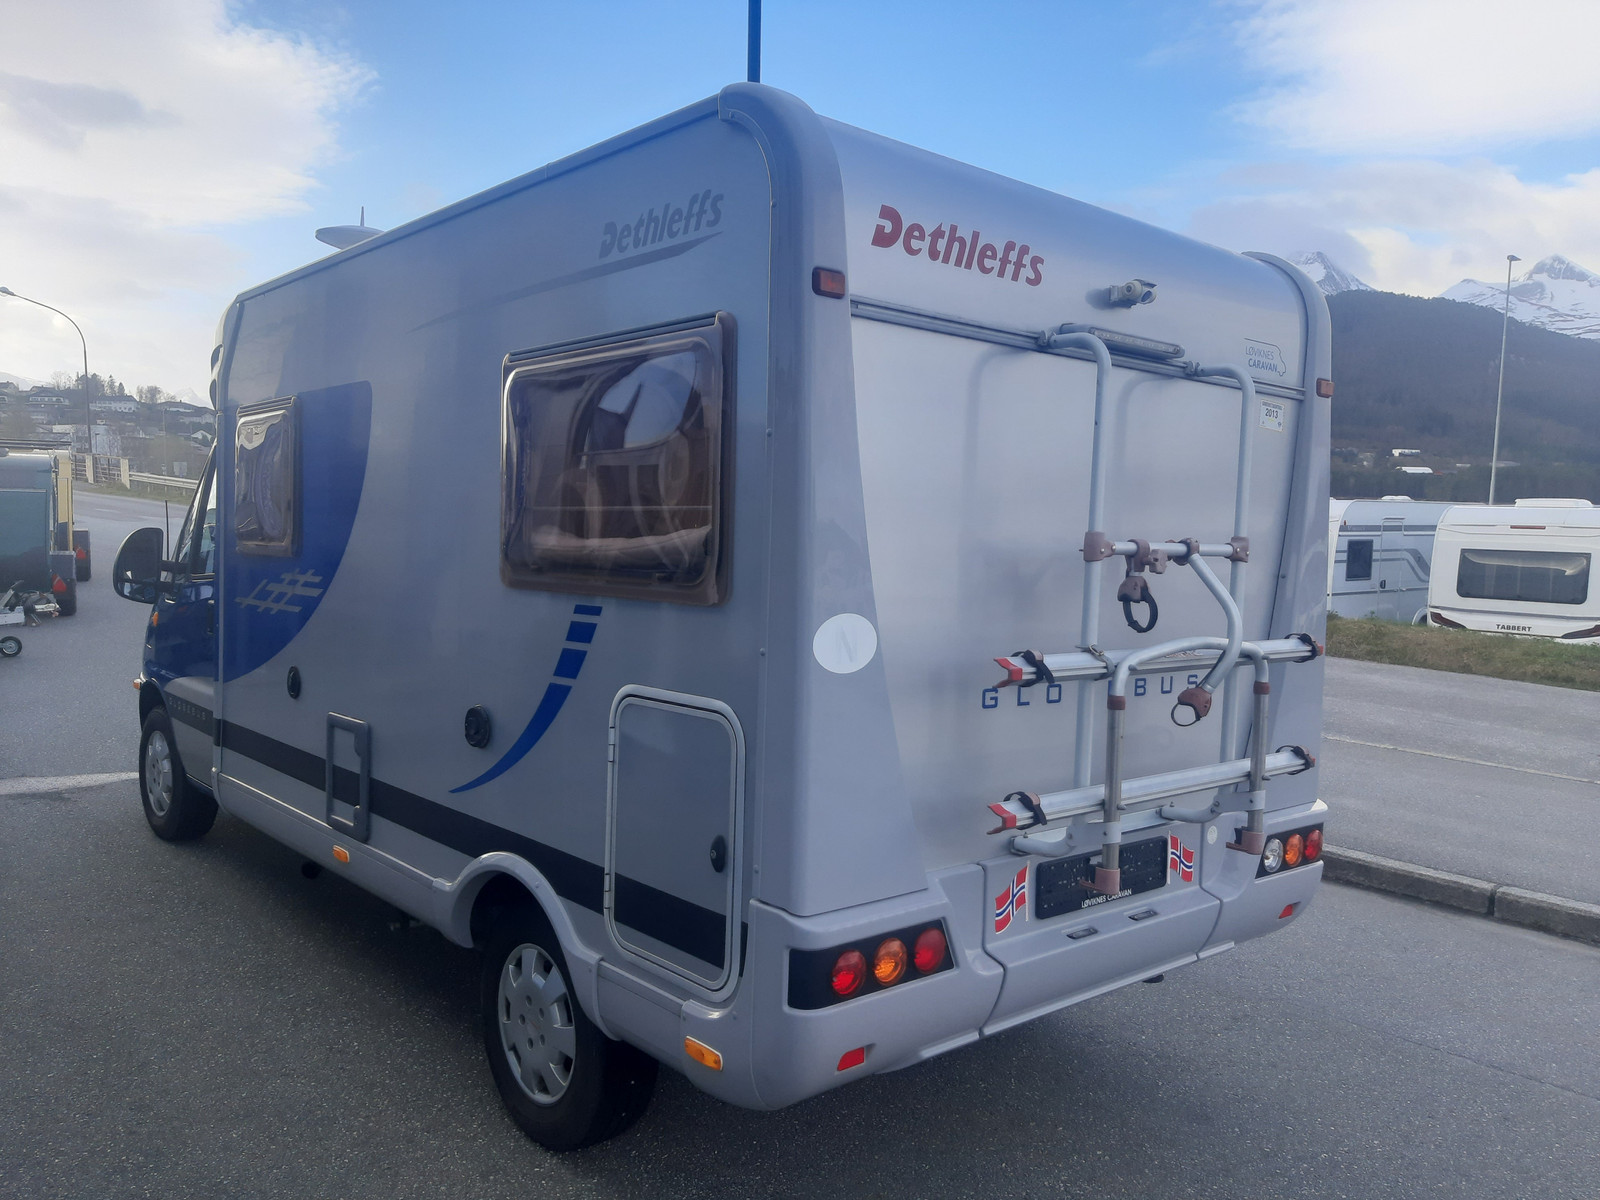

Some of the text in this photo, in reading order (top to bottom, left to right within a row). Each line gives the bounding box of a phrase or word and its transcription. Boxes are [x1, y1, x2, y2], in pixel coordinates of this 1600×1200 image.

[599, 188, 725, 259] Dethleffs
[871, 203, 1045, 287] Dethleffs
[1245, 345, 1275, 361] LØVIKNES
[1248, 358, 1278, 373] CARAVAN
[1265, 407, 1279, 419] 2013
[1496, 623, 1532, 632] TABBERT
